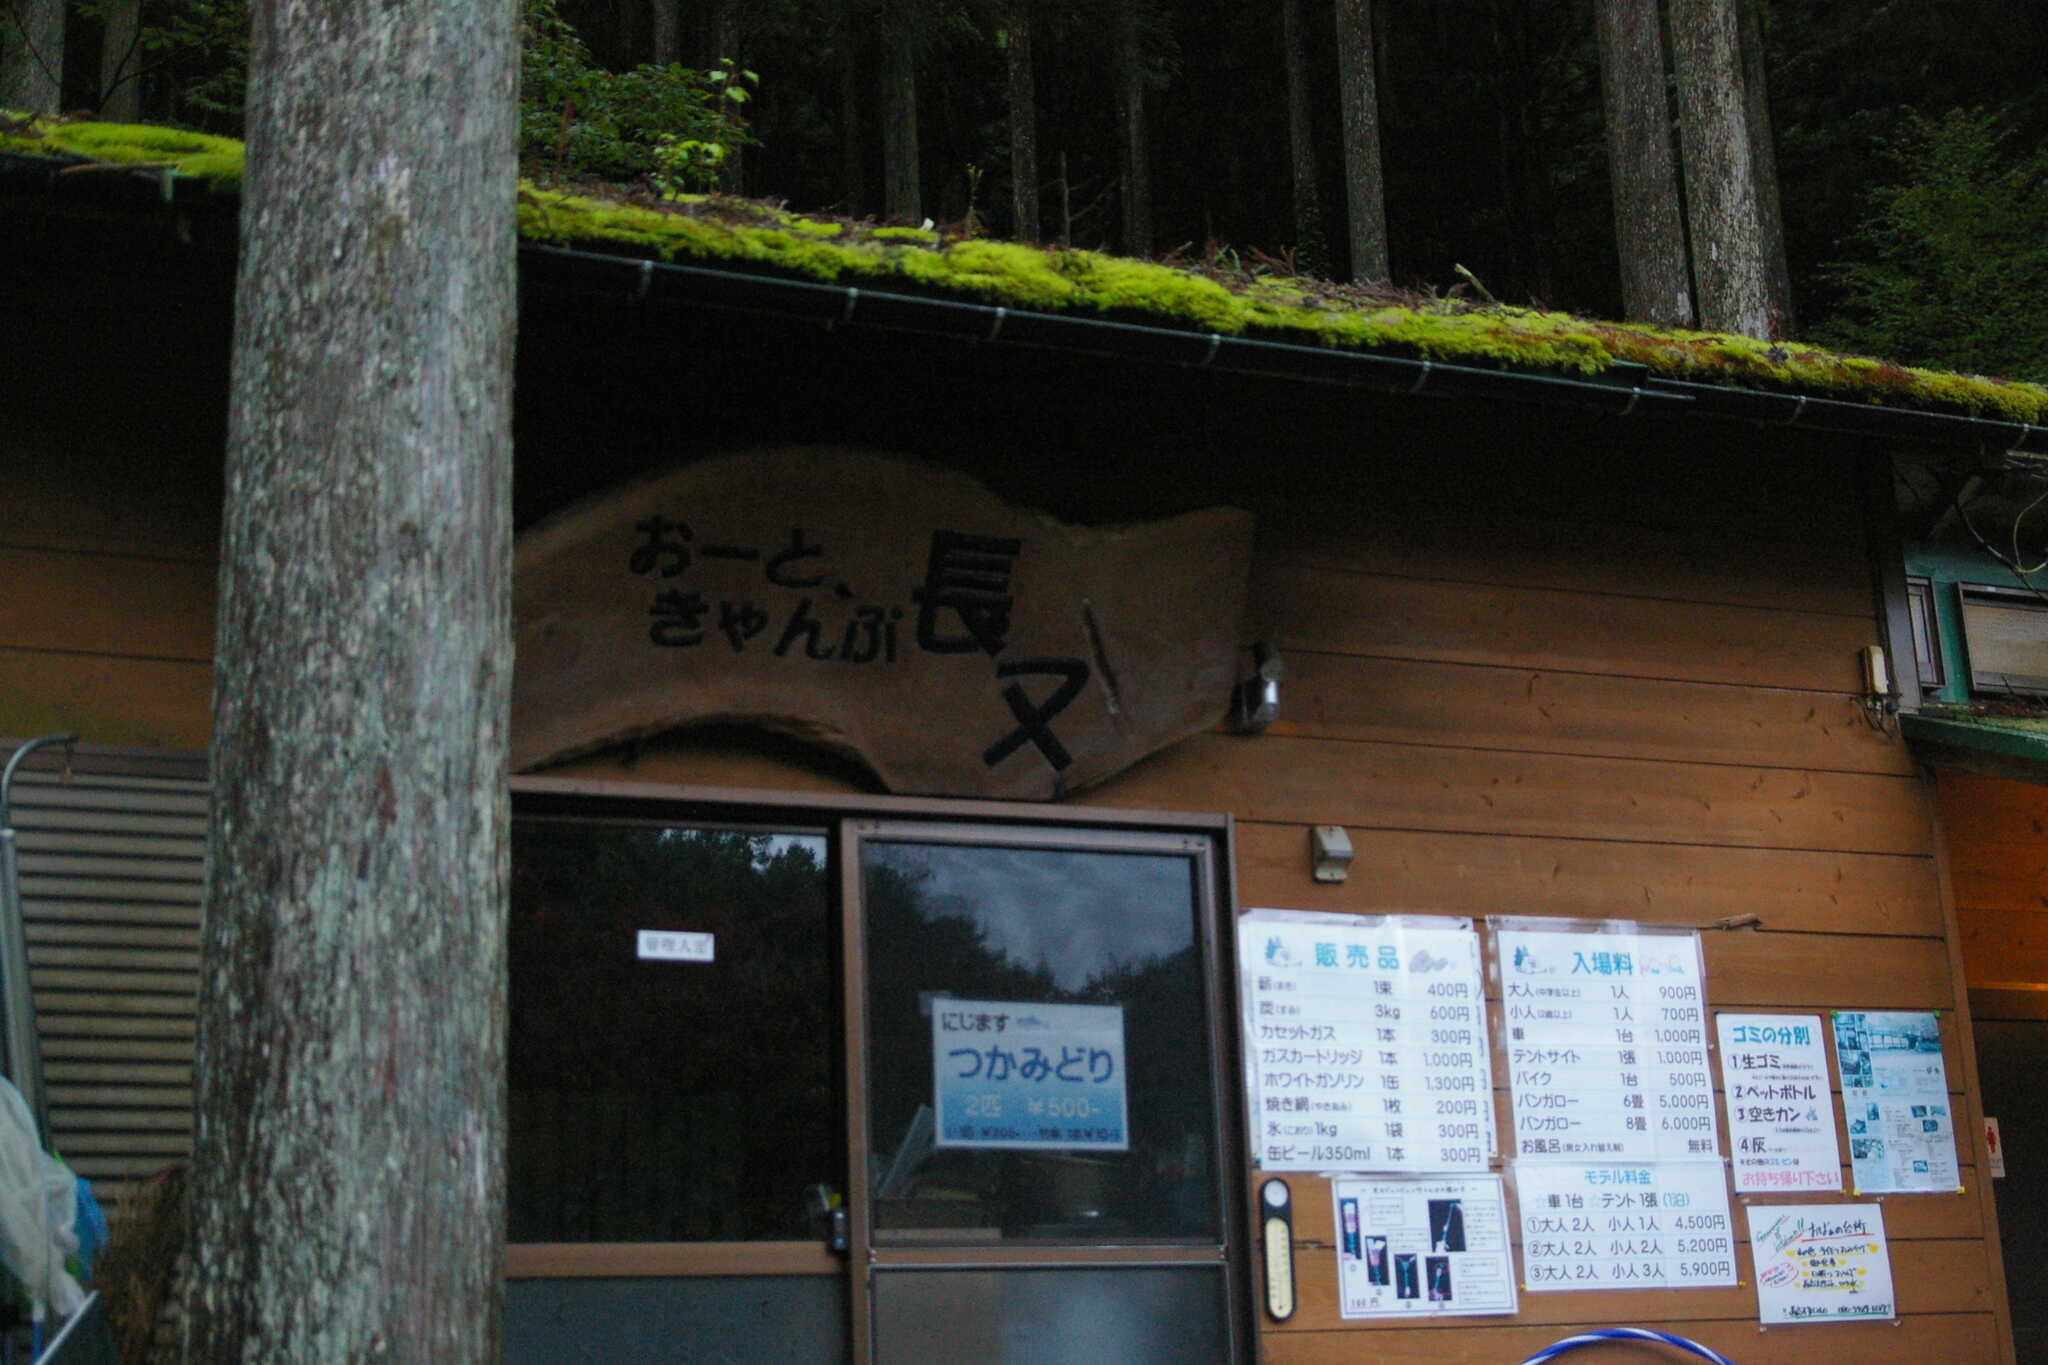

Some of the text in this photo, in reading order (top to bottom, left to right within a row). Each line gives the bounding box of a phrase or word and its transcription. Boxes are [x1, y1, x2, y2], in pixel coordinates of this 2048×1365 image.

[649, 588, 903, 664] きゃんぷ
[1315, 943, 1399, 970] 販売品
[1571, 952, 1633, 976] 入場料
[1427, 983, 1469, 998] 400円
[1611, 985, 1629, 1000] 1人
[1659, 986, 1697, 1000] 900円
[1375, 1004, 1400, 1019] 3kg
[1430, 1007, 1470, 1021] 600円
[1614, 1006, 1633, 1021] 1人
[1661, 1008, 1699, 1022] 700円
[942, 1012, 1009, 1032] にじます
[1261, 1025, 1471, 1045] カセットガス 1本 300円
[1512, 1027, 1525, 1041] 車
[1617, 1029, 1633, 1043] 1台
[1733, 1026, 1811, 1046] ゴミの分別
[949, 1044, 1114, 1083] つかみどり
[1263, 1048, 1363, 1065] ガスカートリッジ
[1380, 1052, 1397, 1066] 1本
[1513, 1049, 1581, 1064] テントサイト
[1619, 1050, 1636, 1065] 1張
[1264, 1072, 1364, 1089] ホワイトガソリン
[1381, 1075, 1399, 1090] 1缶
[1516, 1071, 1706, 1087] バイク 1台 500円
[1384, 1098, 1401, 1113] 1枚
[1436, 1100, 1477, 1116] 200円
[1518, 1094, 1578, 1108] バンガロー
[1623, 1094, 1644, 1109] 6畳
[1385, 1122, 1403, 1137] 1袋
[1439, 1124, 1479, 1139] 300円
[1520, 1116, 1581, 1131] バンガロー
[1626, 1116, 1647, 1131] 8畳
[1267, 1145, 1480, 1163] 缶ビール350ml 1本 300円
[1688, 1139, 1713, 1154] 無料
[1584, 1170, 1652, 1185] モデル料金
[1742, 1171, 1840, 1187] お持ち帰り下さい
[1548, 1194, 1560, 1208] 車
[1566, 1194, 1583, 1208] 1台
[1602, 1193, 1635, 1208] テント
[1640, 1192, 1658, 1208] 1張
[1572, 1216, 1595, 1232] 2人
[1608, 1216, 1635, 1232] 小人
[1639, 1216, 1660, 1231] 1人
[1574, 1240, 1597, 1256] 2人
[1610, 1240, 1637, 1256] 小人
[1641, 1239, 1663, 1255] 2人
[1576, 1264, 1599, 1280] 2人
[1612, 1263, 1639, 1279] 小人
[1643, 1262, 1664, 1278] 3人
